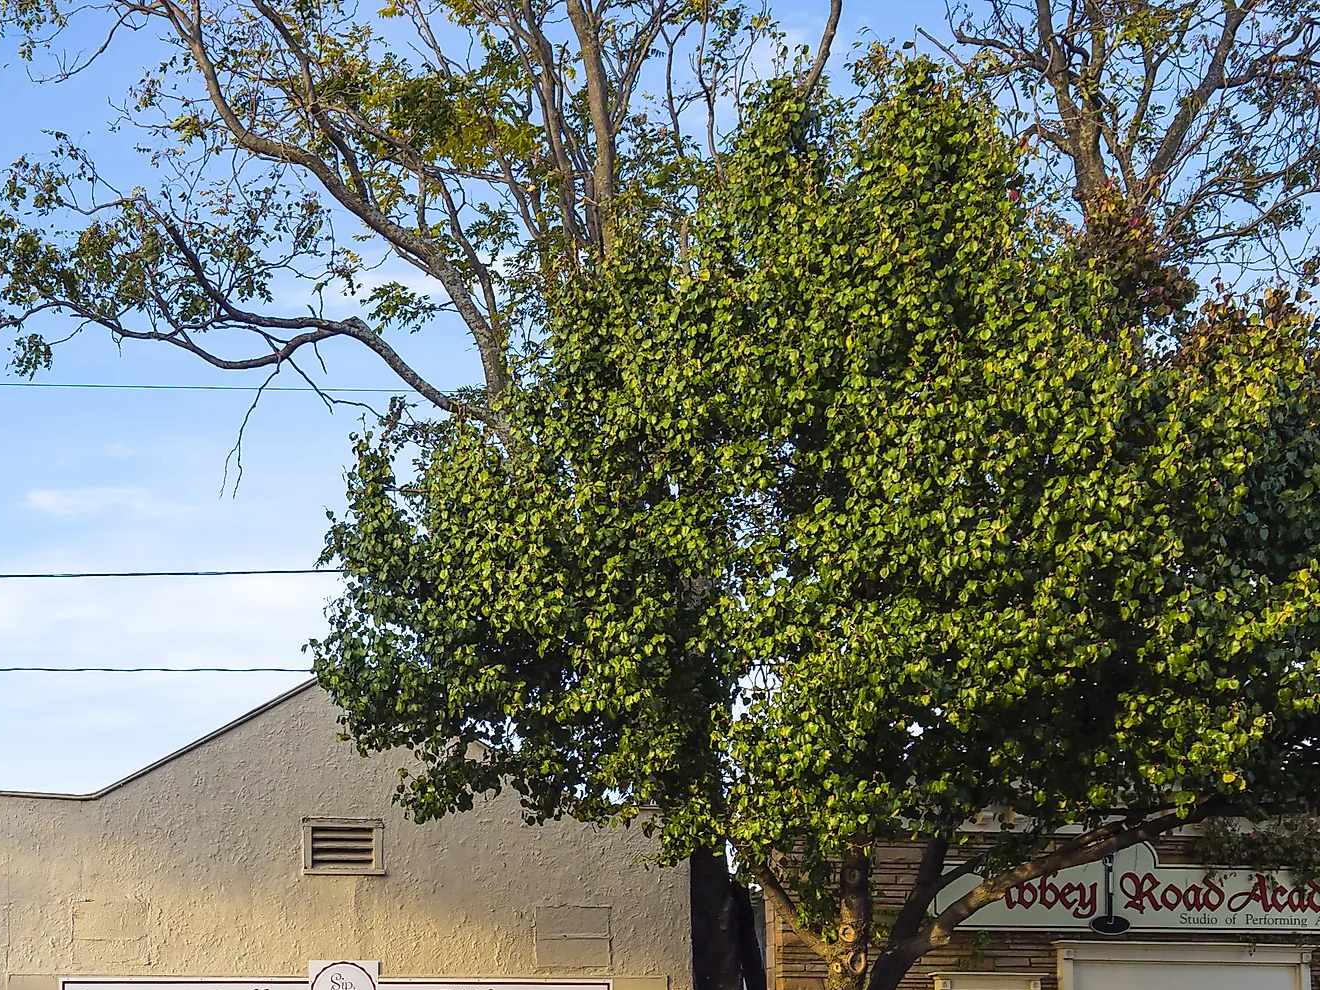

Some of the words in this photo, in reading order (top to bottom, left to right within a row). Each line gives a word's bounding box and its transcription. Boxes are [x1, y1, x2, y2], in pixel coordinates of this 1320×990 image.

[1119, 872, 1226, 915] Road
[1180, 913, 1218, 925] Studio
[1225, 913, 1238, 925] of
[1246, 913, 1308, 927] Performing
